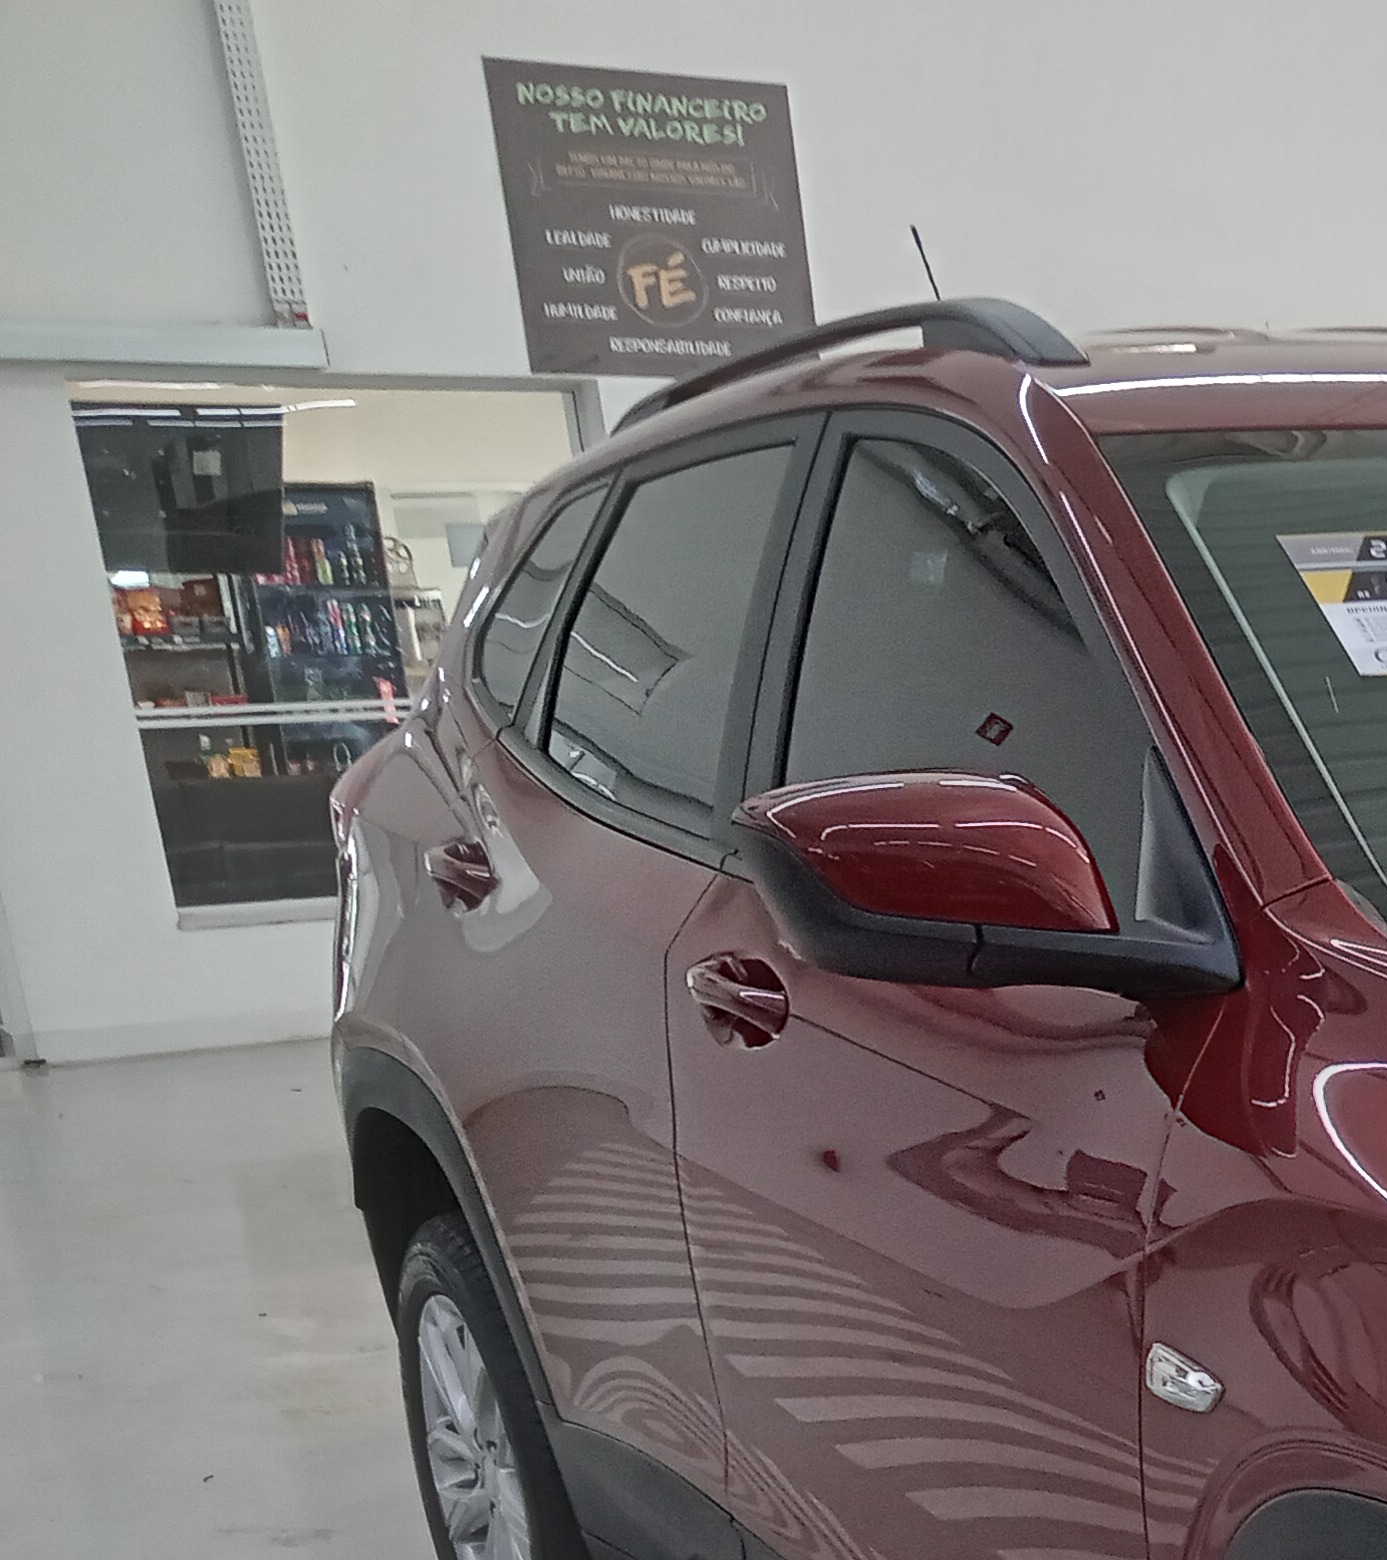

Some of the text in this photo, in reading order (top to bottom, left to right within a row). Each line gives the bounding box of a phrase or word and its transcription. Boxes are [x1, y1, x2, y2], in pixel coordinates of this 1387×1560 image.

[515, 81, 767, 125] NOSSO FINANCEIRO
[548, 111, 745, 147] TEM VALORES!
[608, 203, 696, 225] HONESTIDADE
[544, 228, 612, 249] LEALDADE
[701, 236, 787, 258] CUMPLICIDADE
[561, 264, 606, 285] UNIÃO
[626, 251, 697, 310] FÉ
[717, 274, 777, 293] RESPEITO
[713, 306, 783, 327] CONFIANÇA
[609, 336, 731, 357] RESPONSABILIDADE
